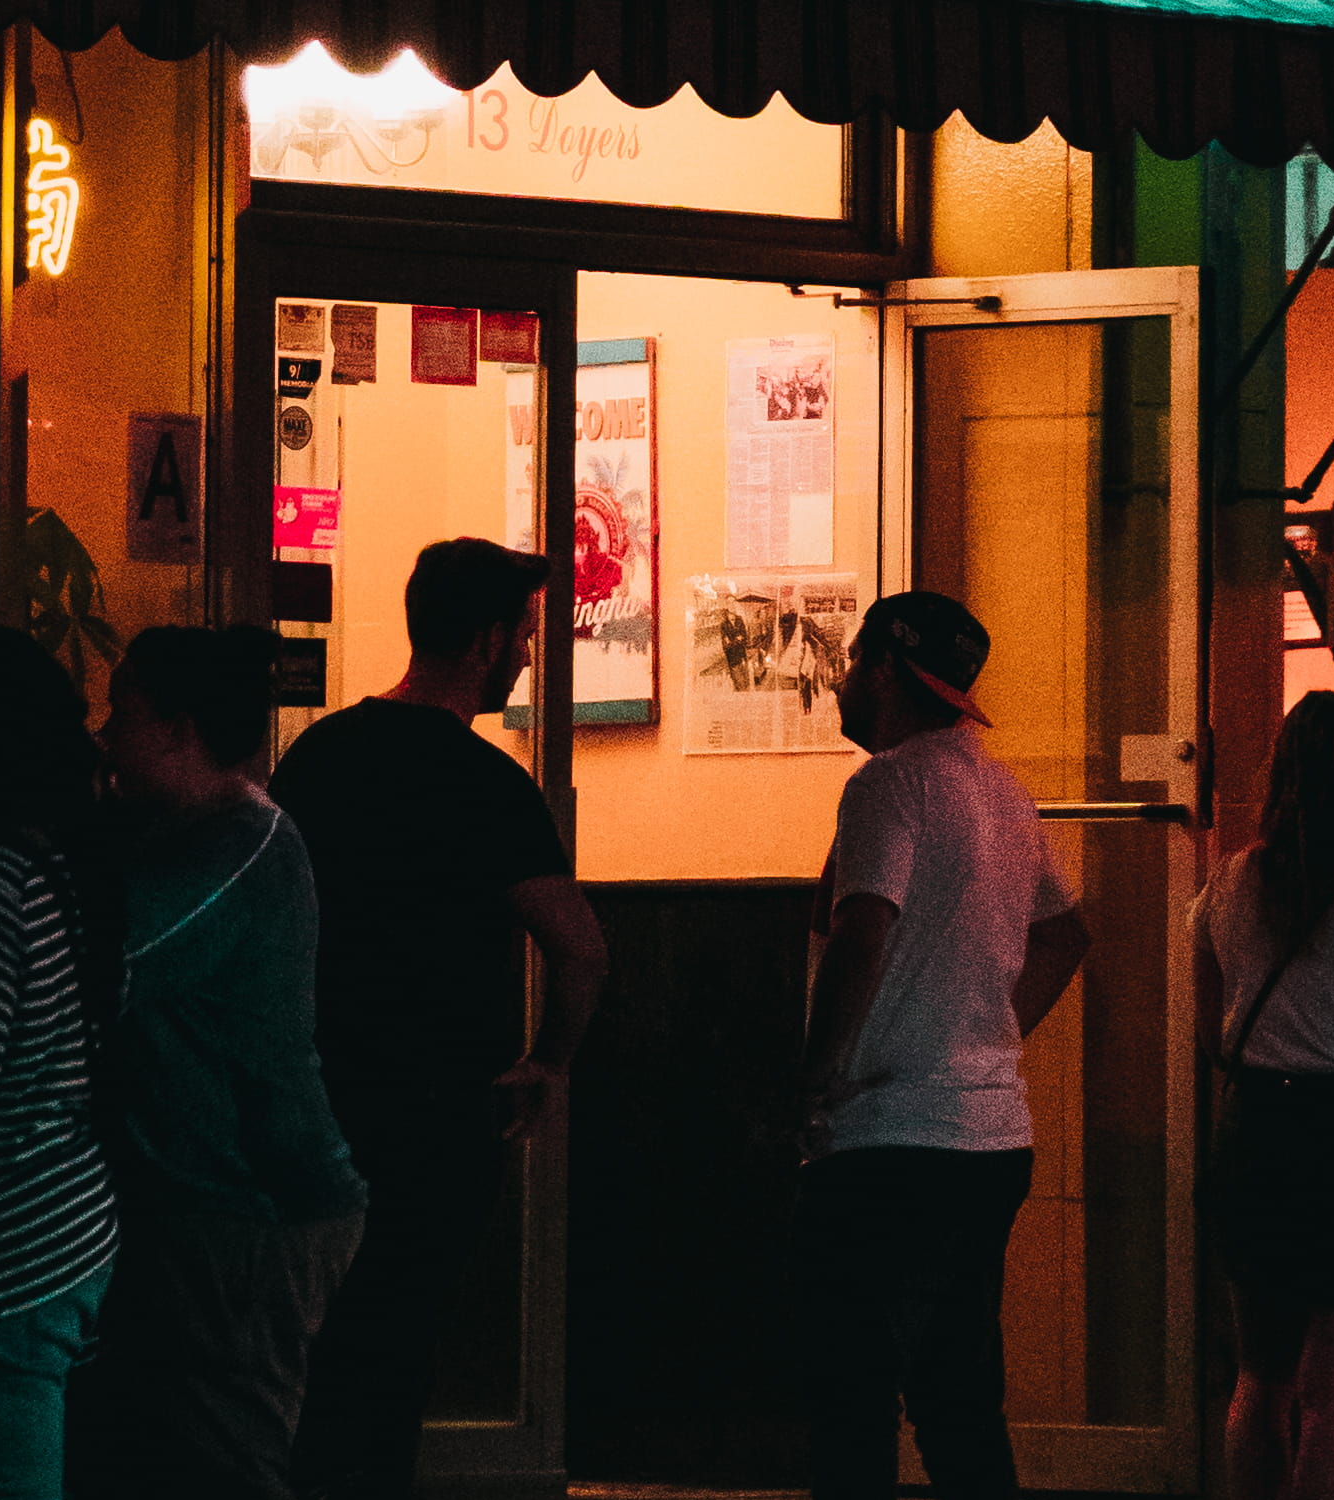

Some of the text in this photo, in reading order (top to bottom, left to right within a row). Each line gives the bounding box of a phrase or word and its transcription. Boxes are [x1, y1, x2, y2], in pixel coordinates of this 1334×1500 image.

[461, 88, 643, 184] 13 Doyers
[139, 430, 188, 523] A
[573, 592, 642, 638] ingha
